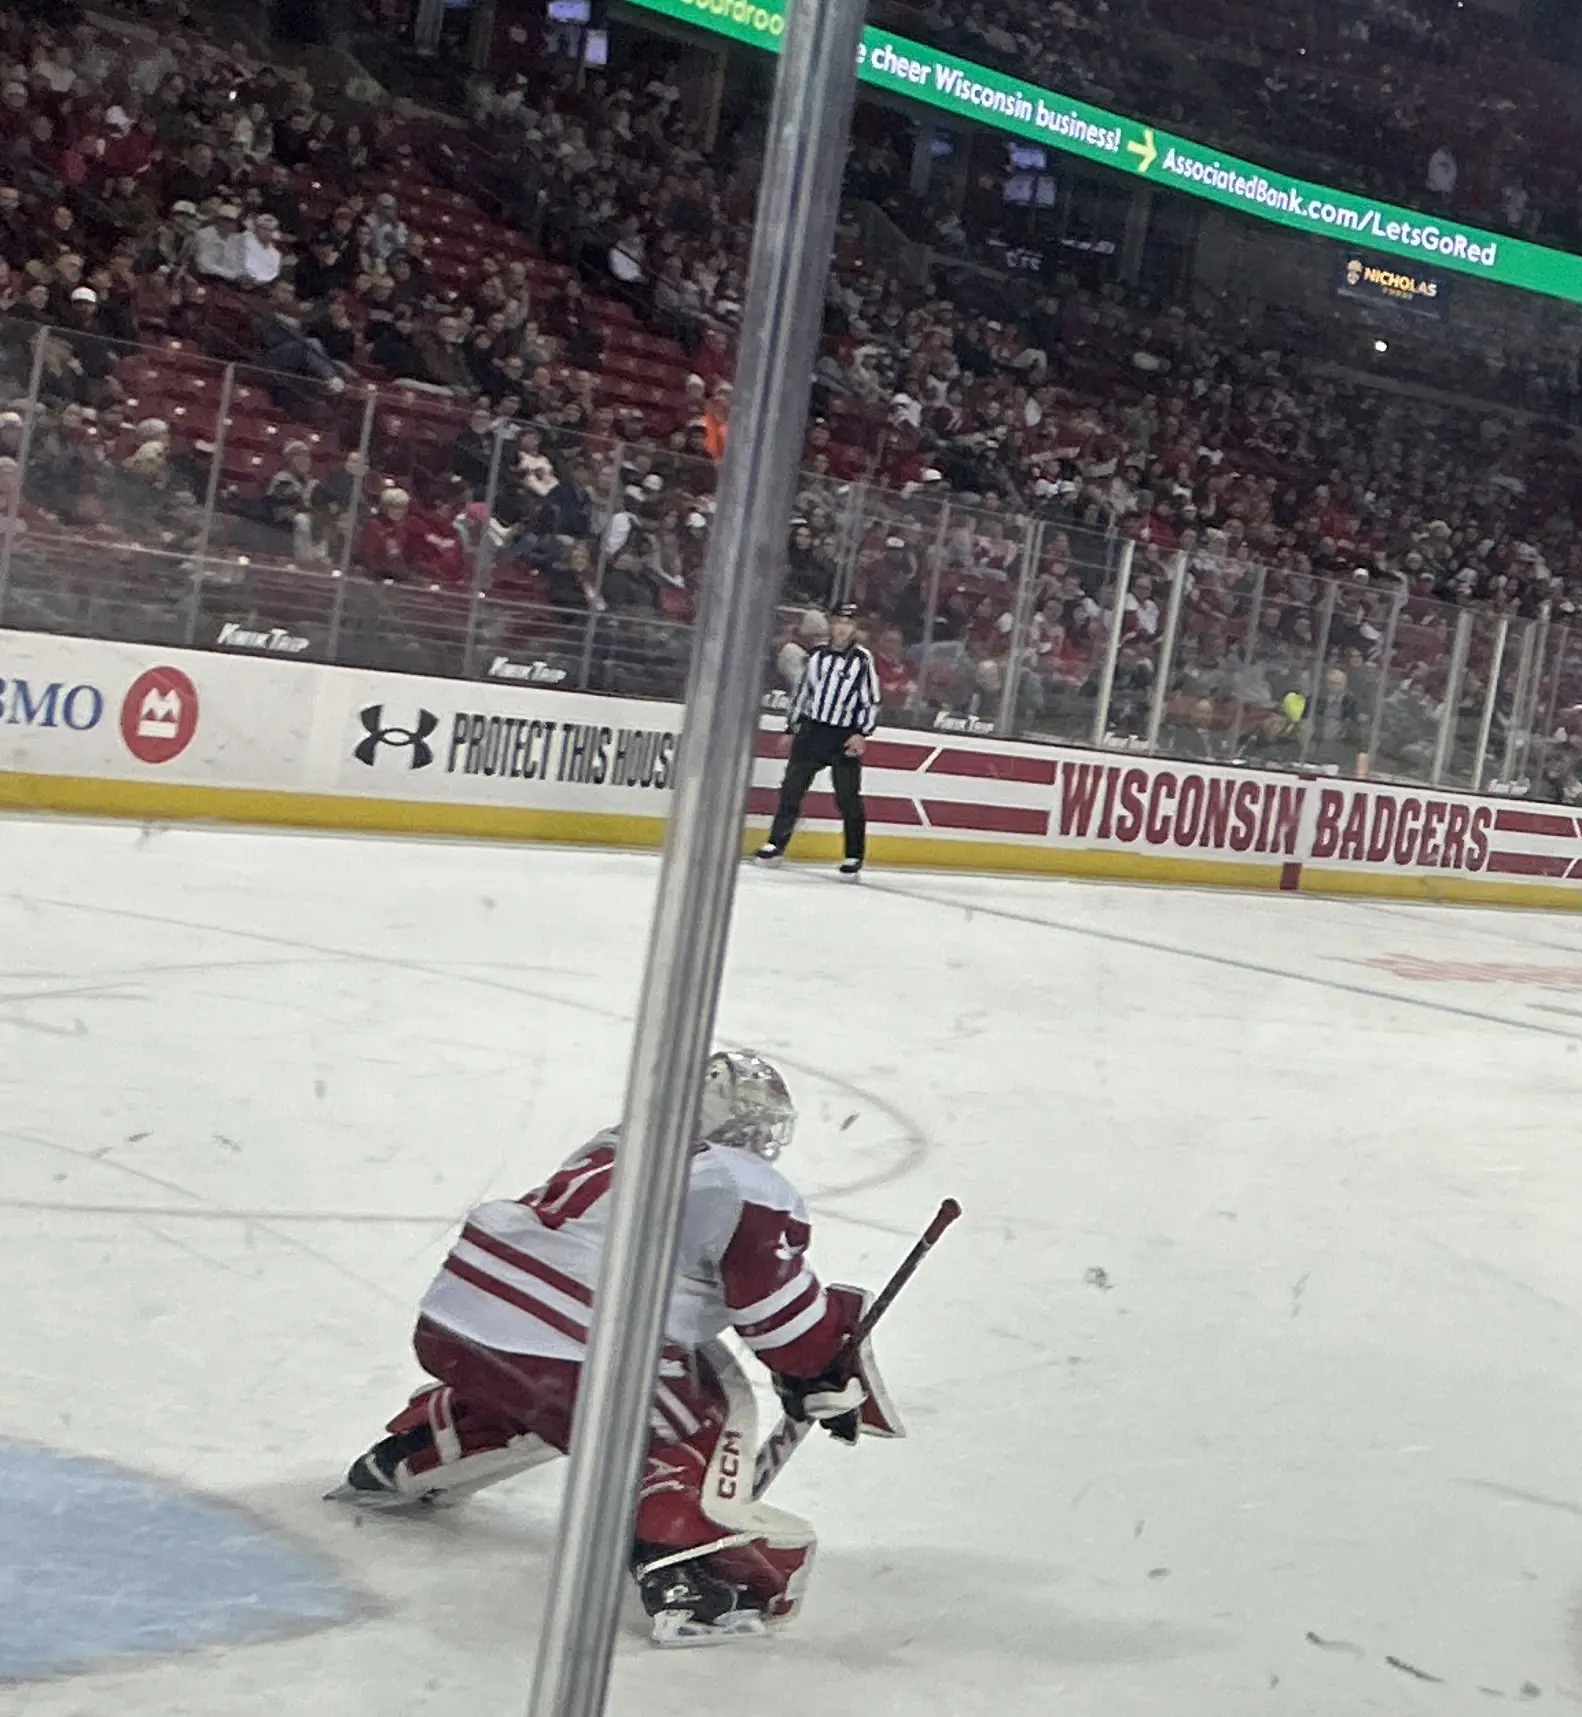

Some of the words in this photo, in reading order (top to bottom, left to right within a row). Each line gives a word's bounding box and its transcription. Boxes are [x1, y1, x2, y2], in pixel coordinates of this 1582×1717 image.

[871, 45, 931, 85] cheer
[934, 64, 1034, 121] Wisconsin
[1035, 99, 1122, 153] business!
[1161, 148, 1497, 267] AssociatedBank.com/LetsGoRed
[1363, 267, 1438, 297] NICHOLAS
[0, 677, 104, 731] MO
[446, 712, 557, 781] PROTECT
[556, 722, 613, 785] THIS
[1058, 761, 1307, 855] WISCONSIN
[1311, 788, 1492, 872] BADGERS
[717, 1430, 743, 1499] CCM
